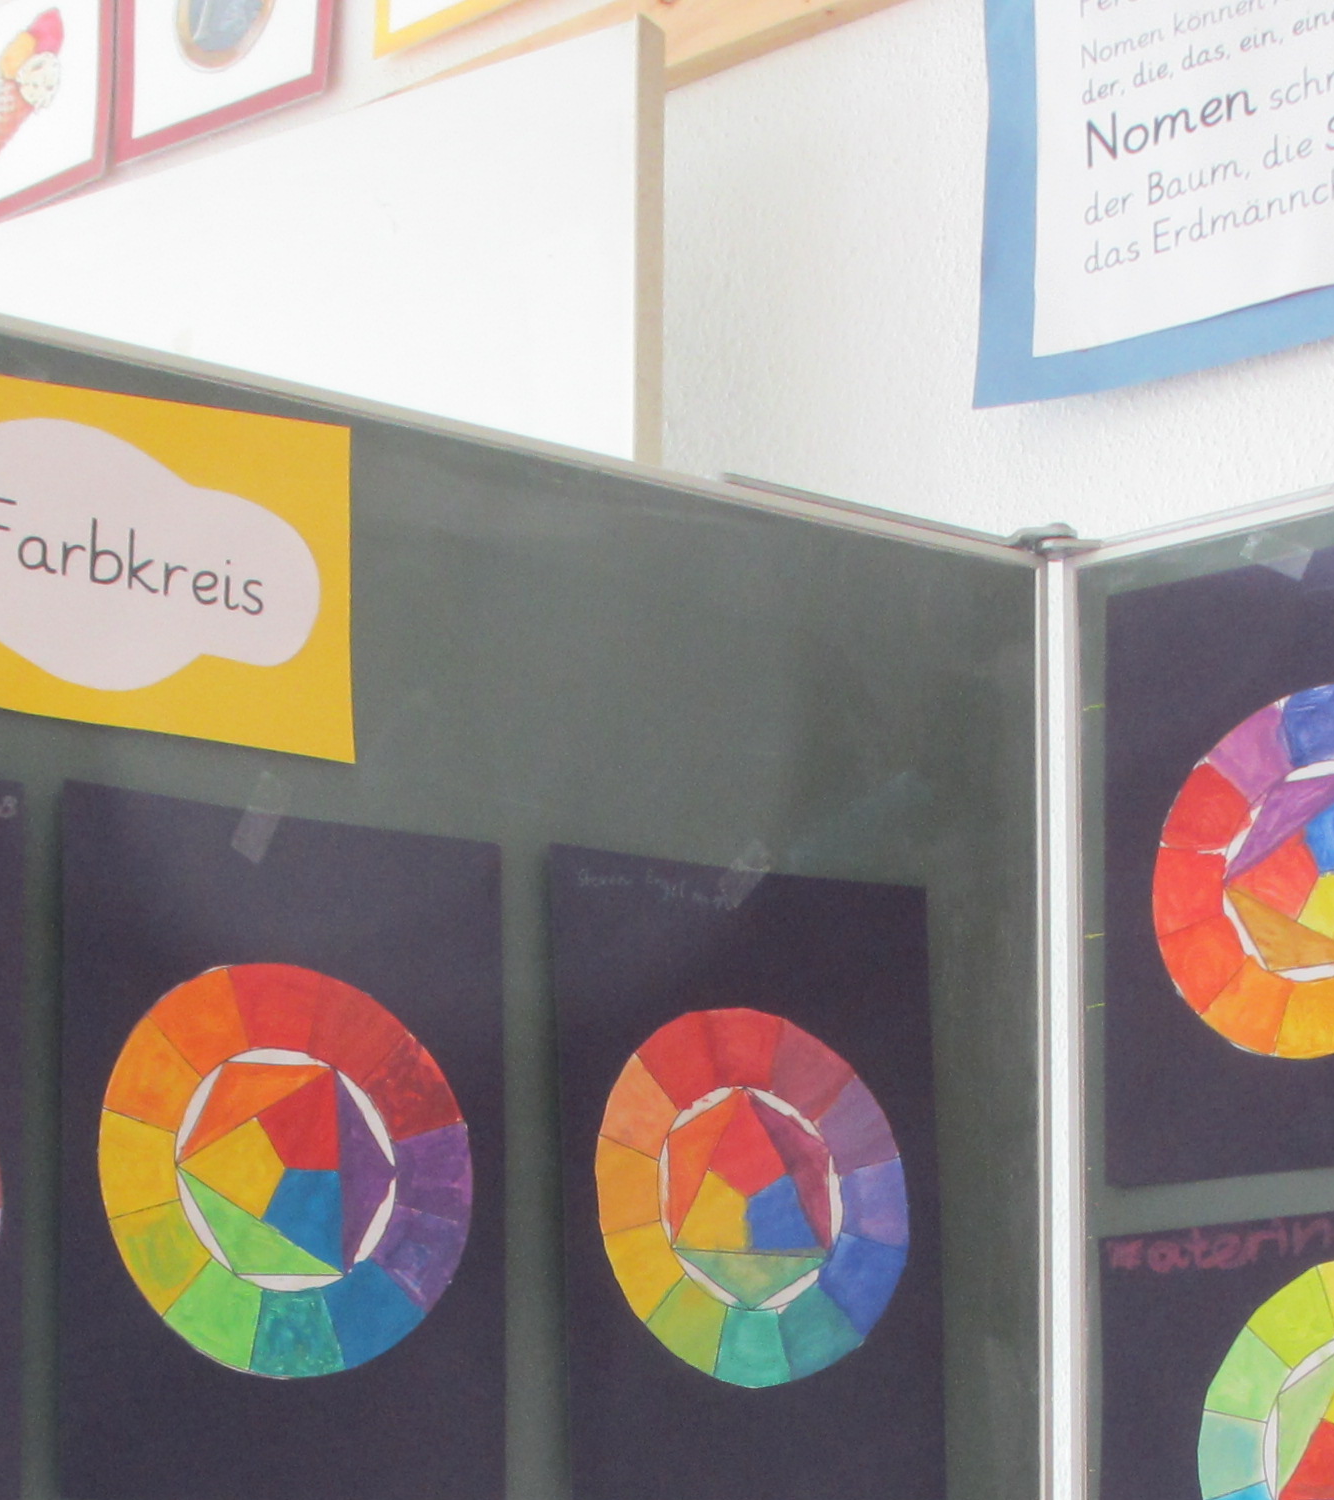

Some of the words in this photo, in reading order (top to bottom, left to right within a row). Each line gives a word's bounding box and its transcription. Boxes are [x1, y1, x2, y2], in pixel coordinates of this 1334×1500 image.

[1080, 28, 1165, 69] Nomen
[1081, 79, 1126, 105] der,
[1132, 61, 1175, 88] die,
[1181, 44, 1231, 71] das,
[1239, 28, 1285, 52] ein,
[1086, 88, 1258, 170] Nomen
[1084, 190, 1134, 226] der
[1147, 158, 1251, 207] Baum,
[1263, 133, 1313, 171] die
[1084, 240, 1141, 275] das
